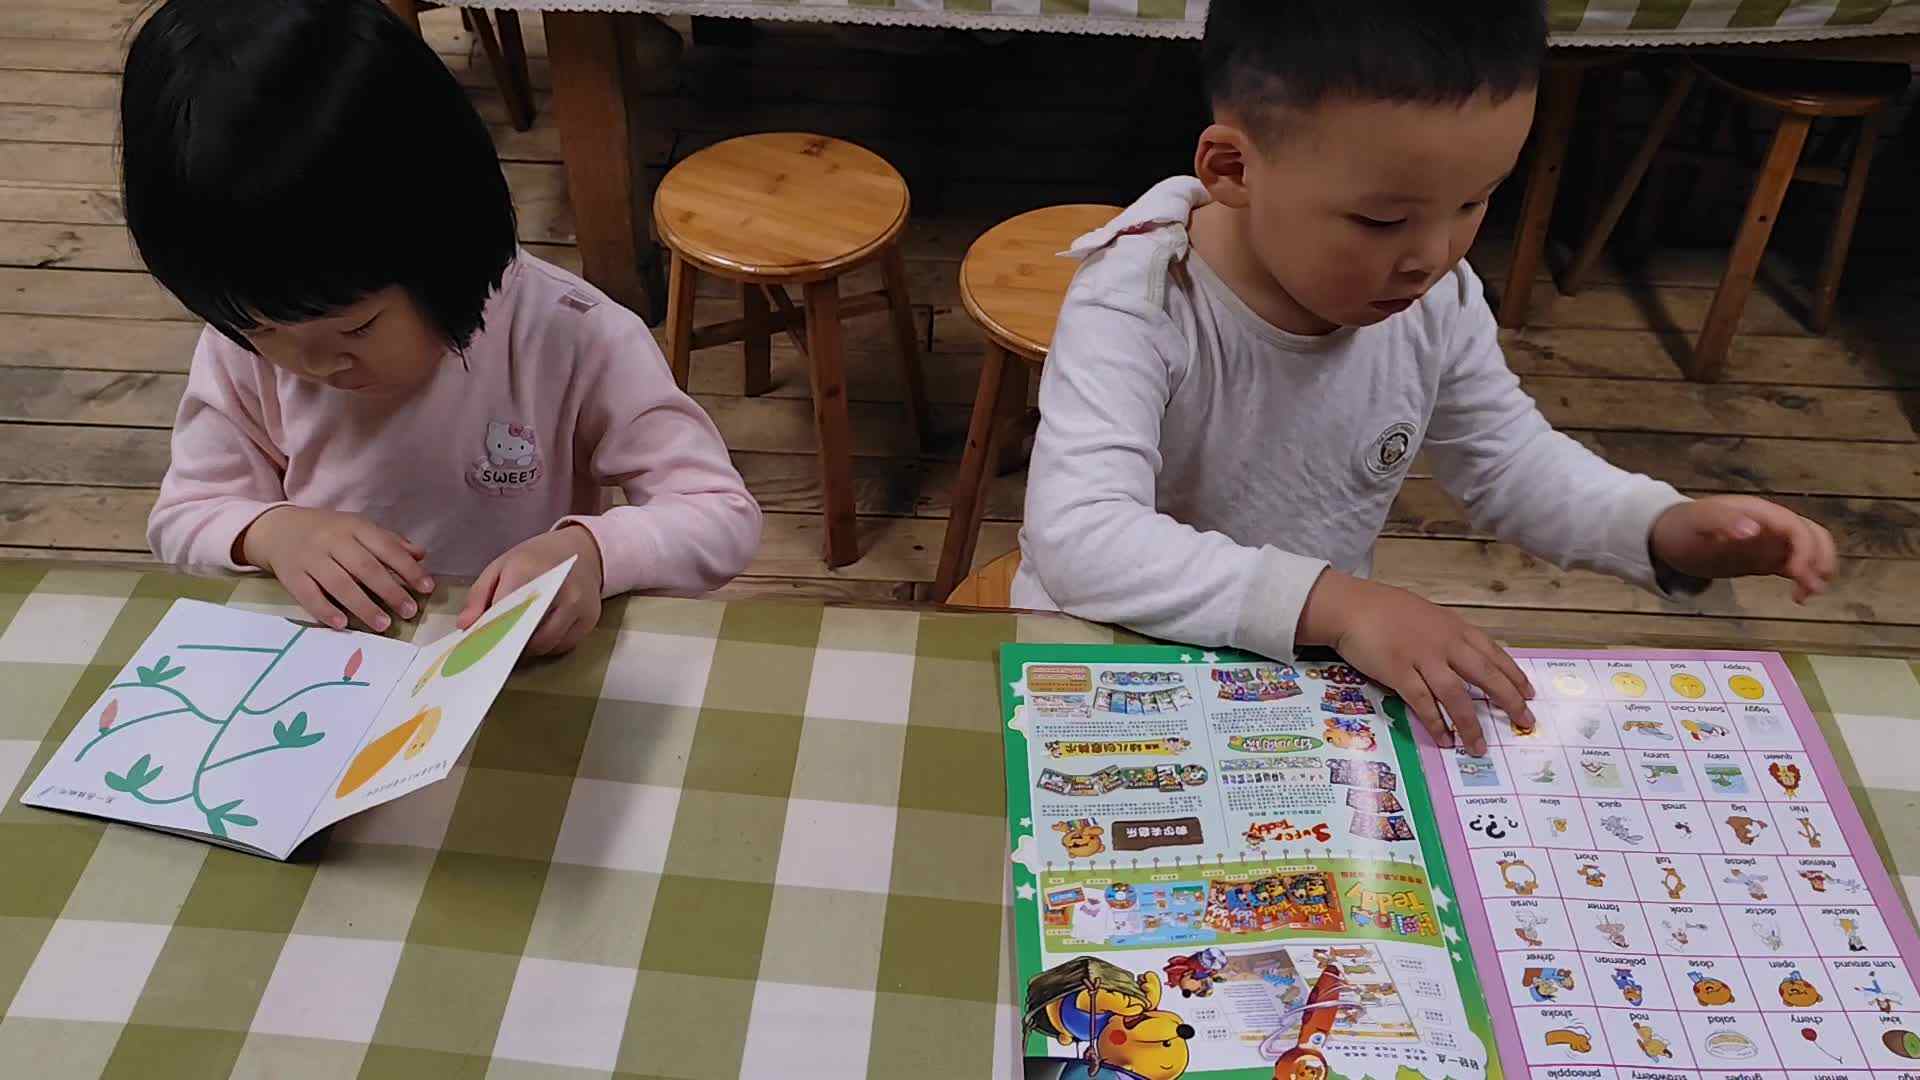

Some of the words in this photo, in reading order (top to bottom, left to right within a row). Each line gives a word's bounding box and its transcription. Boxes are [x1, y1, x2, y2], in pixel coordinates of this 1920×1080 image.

[482, 468, 537, 484] SWEET
[1699, 705, 1726, 713] Santa
[1466, 797, 1508, 805] question
[1597, 800, 1623, 808] quick
[1661, 803, 1688, 811] small
[1731, 804, 1748, 813] big
[1789, 804, 1810, 813] thin
[1503, 850, 1517, 859] fat
[1575, 853, 1600, 862] short
[1655, 856, 1672, 864] tall
[1724, 857, 1757, 866] please
[1798, 859, 1837, 868] fireman
[1588, 902, 1621, 912] farmer
[1670, 906, 1694, 915] cook
[1744, 907, 1777, 916] doctor
[1821, 907, 1861, 916] teacher
[1526, 953, 1555, 962] driver
[1594, 956, 1647, 966] policeman
[1688, 959, 1715, 968] close
[1768, 960, 1796, 969] open
[1833, 961, 1871, 969] around
[1873, 961, 1896, 969] turn
[1540, 1009, 1573, 1018] shake
[1629, 1012, 1649, 1021] nod
[1707, 1015, 1737, 1024] salad
[1790, 1015, 1823, 1025] cherry
[1879, 1016, 1902, 1025] kiwi
[1547, 1068, 1601, 1079] pineapple
[1631, 1070, 1688, 1080] strawberry
